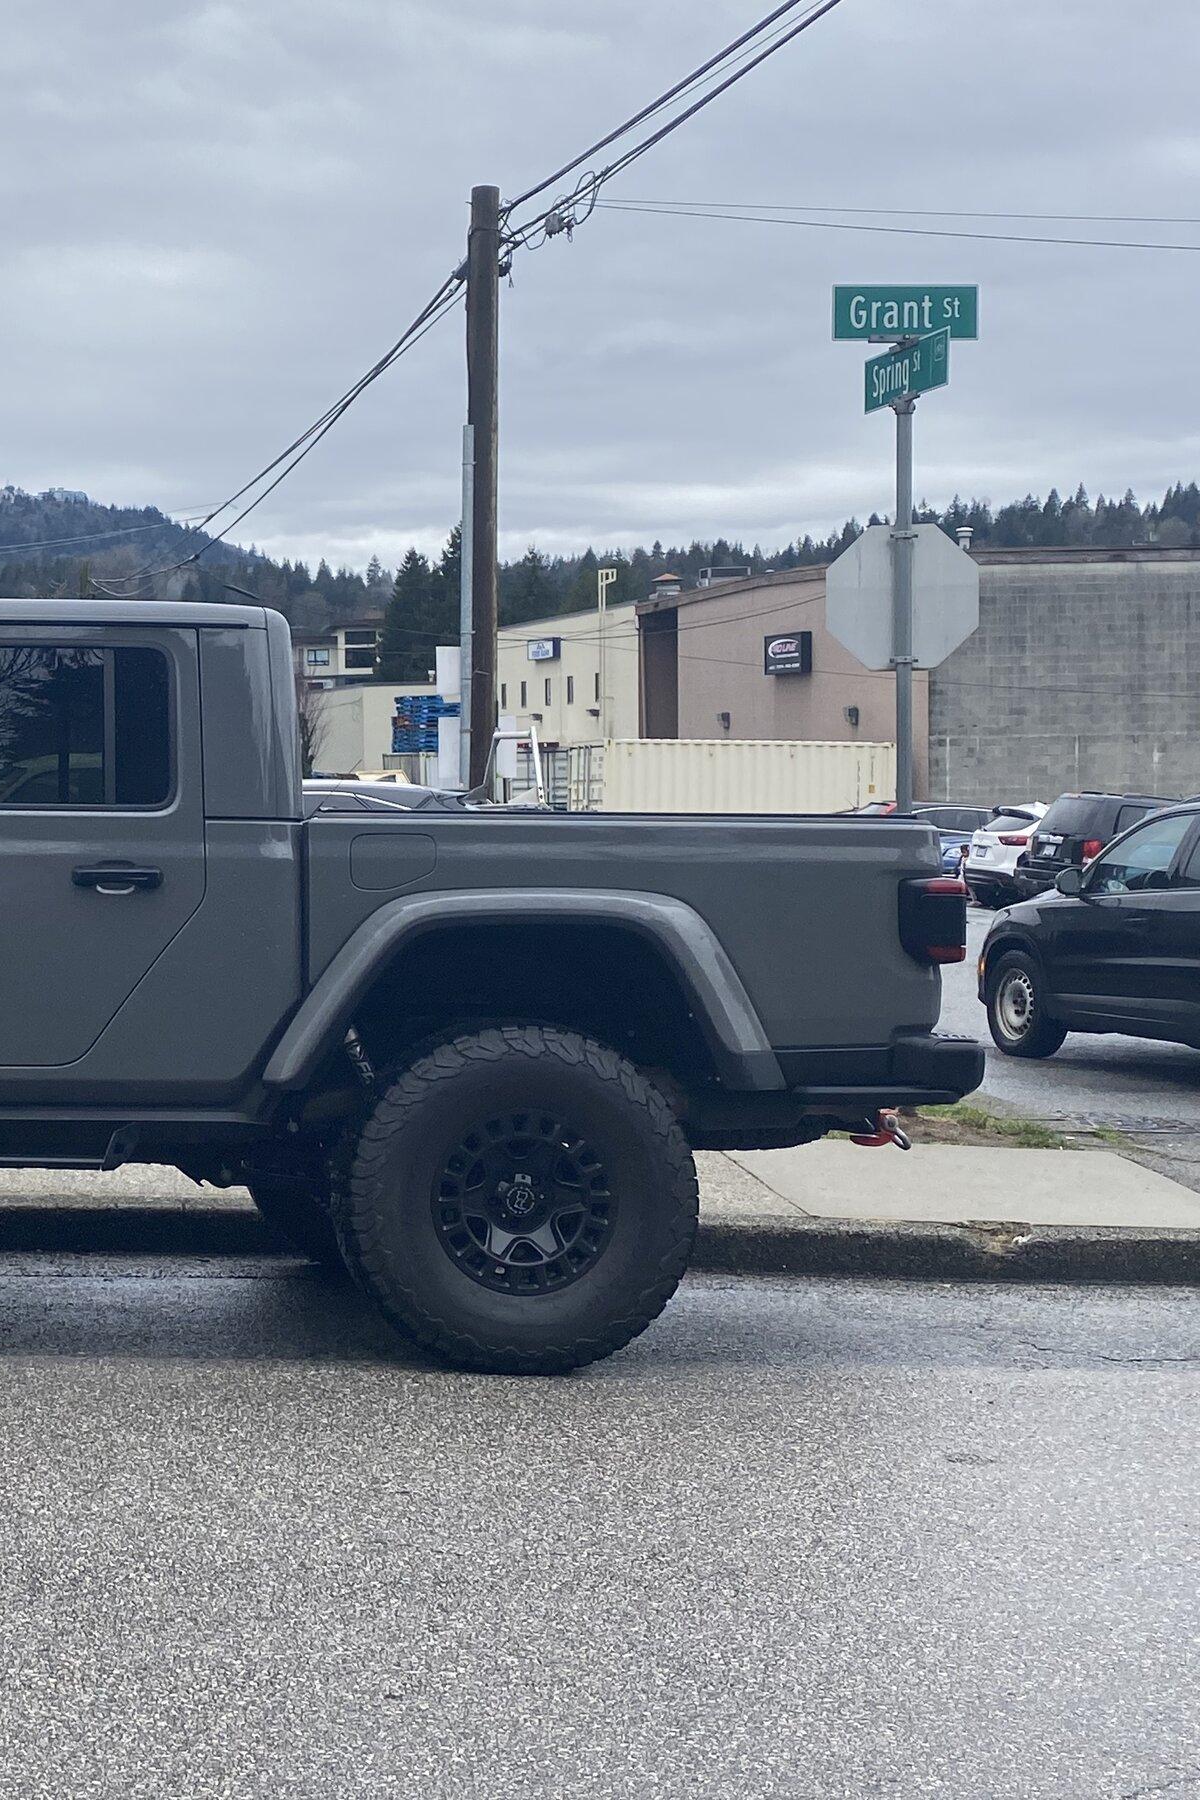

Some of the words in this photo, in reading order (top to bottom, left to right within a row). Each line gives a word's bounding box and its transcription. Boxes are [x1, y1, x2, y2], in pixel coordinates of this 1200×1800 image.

[850, 295, 932, 329] Grant
[943, 297, 960, 318] St
[872, 356, 909, 403] Spring
[912, 349, 921, 372] St
